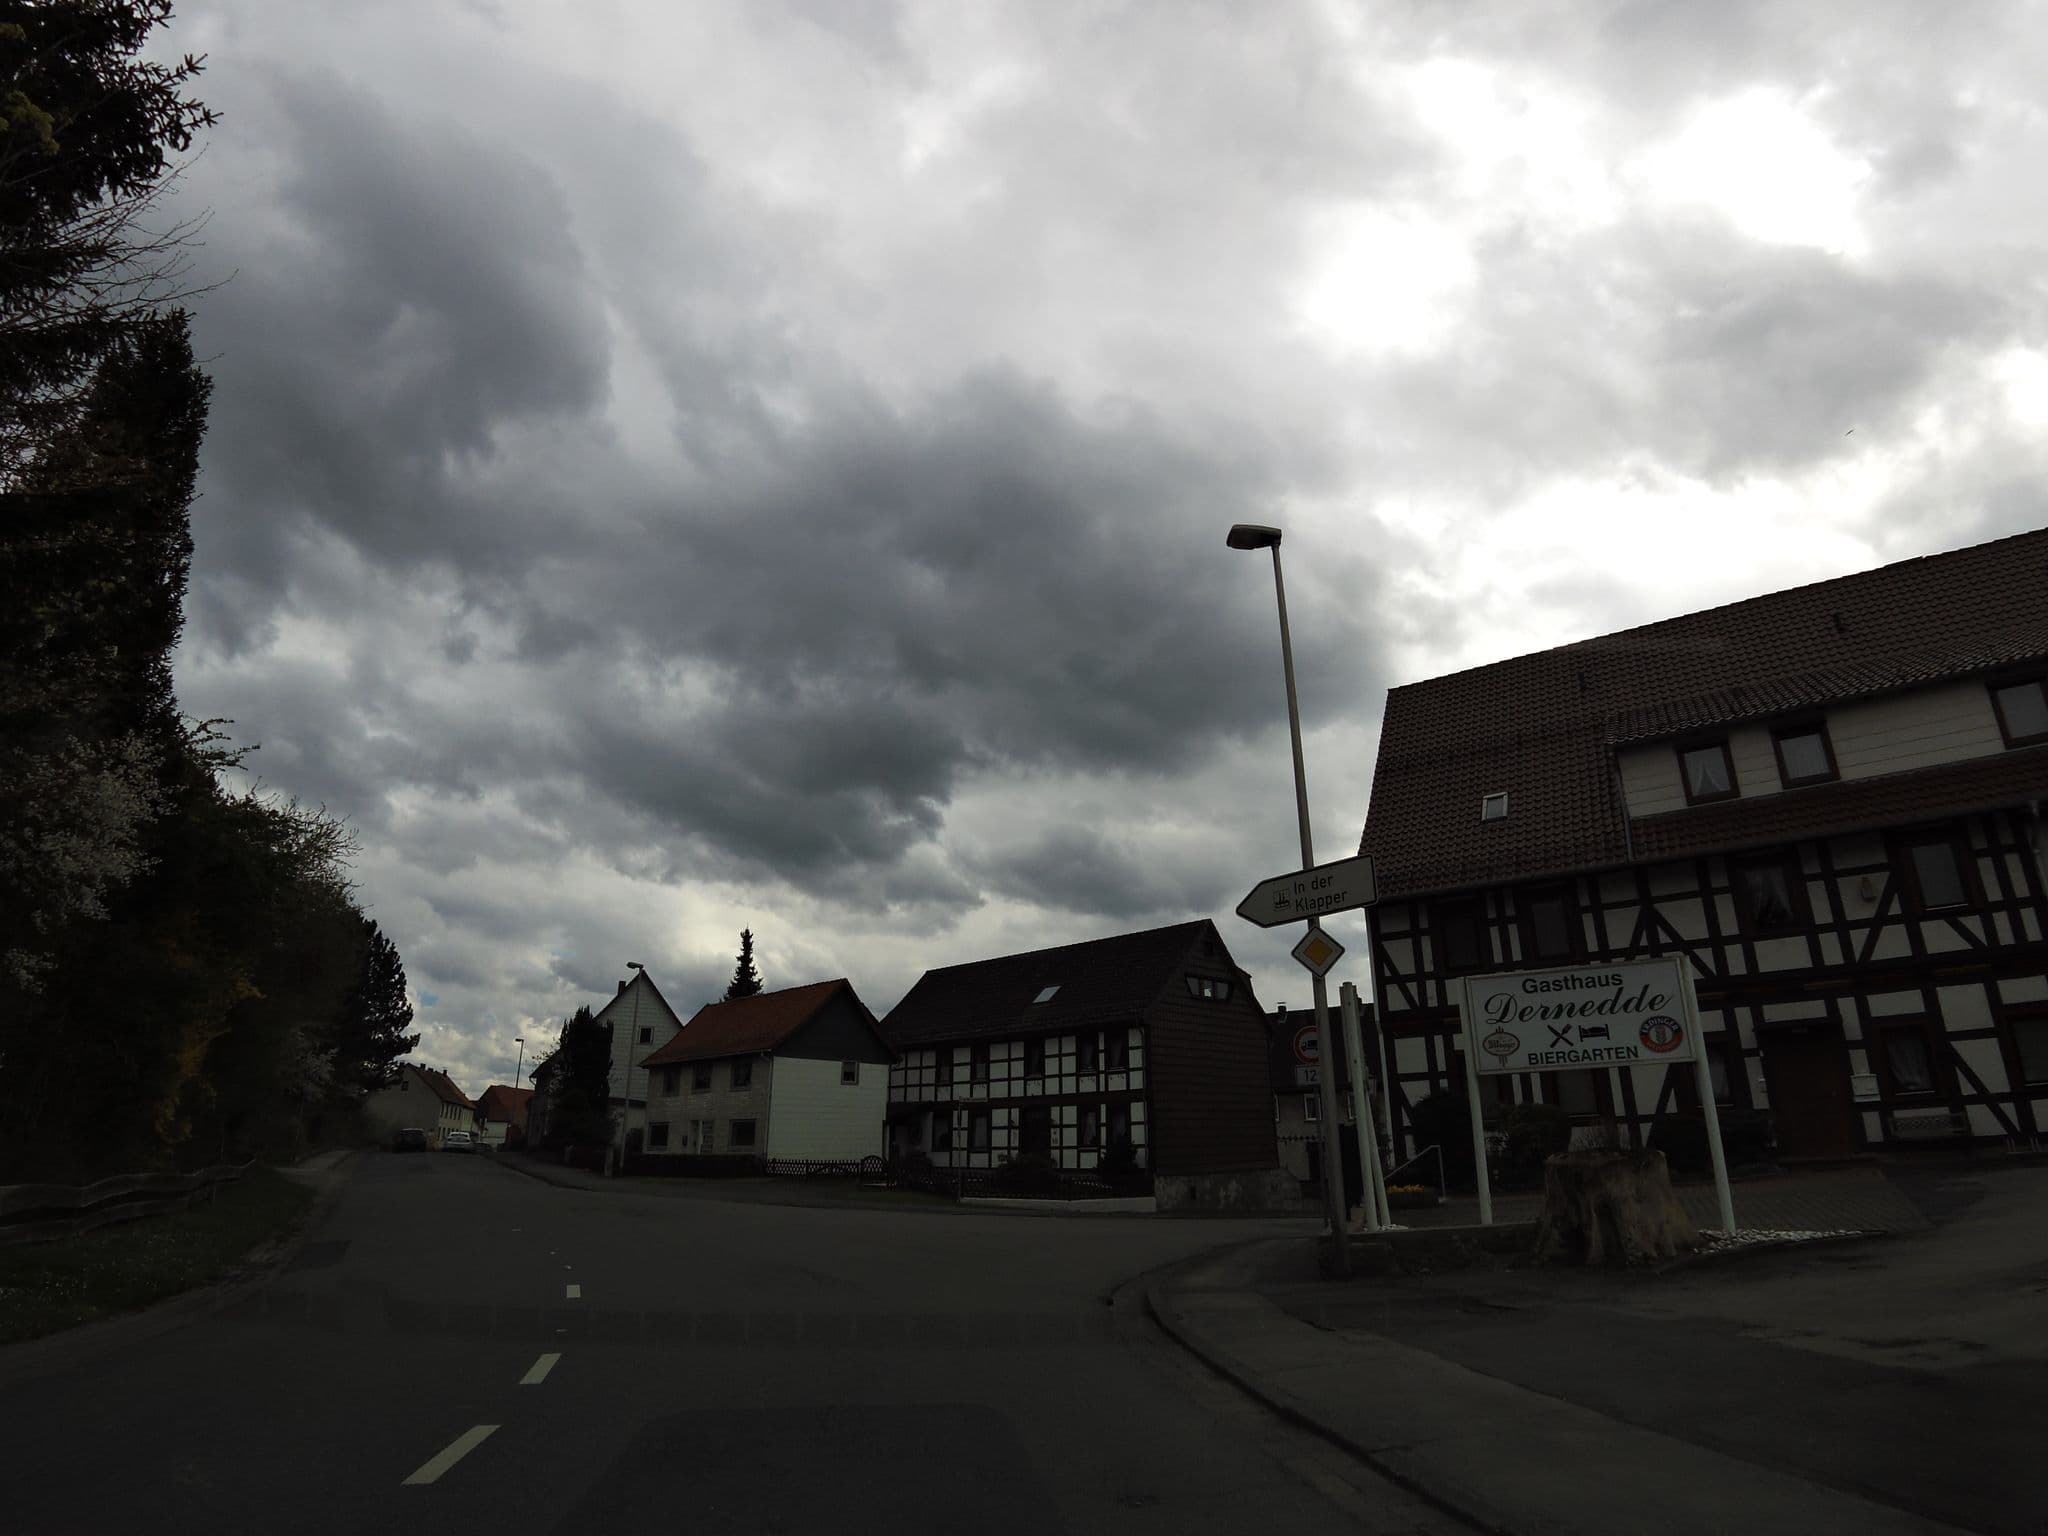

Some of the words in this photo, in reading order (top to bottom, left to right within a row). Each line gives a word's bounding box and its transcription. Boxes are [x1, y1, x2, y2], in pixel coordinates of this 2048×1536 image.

[1294, 881, 1306, 895] In
[1311, 875, 1334, 890] der
[1295, 890, 1347, 912] Klapper
[1522, 973, 1624, 994] Gasthaus
[1484, 983, 1673, 1025] Dernedde
[1528, 1046, 1638, 1066] BIERGARTEN
